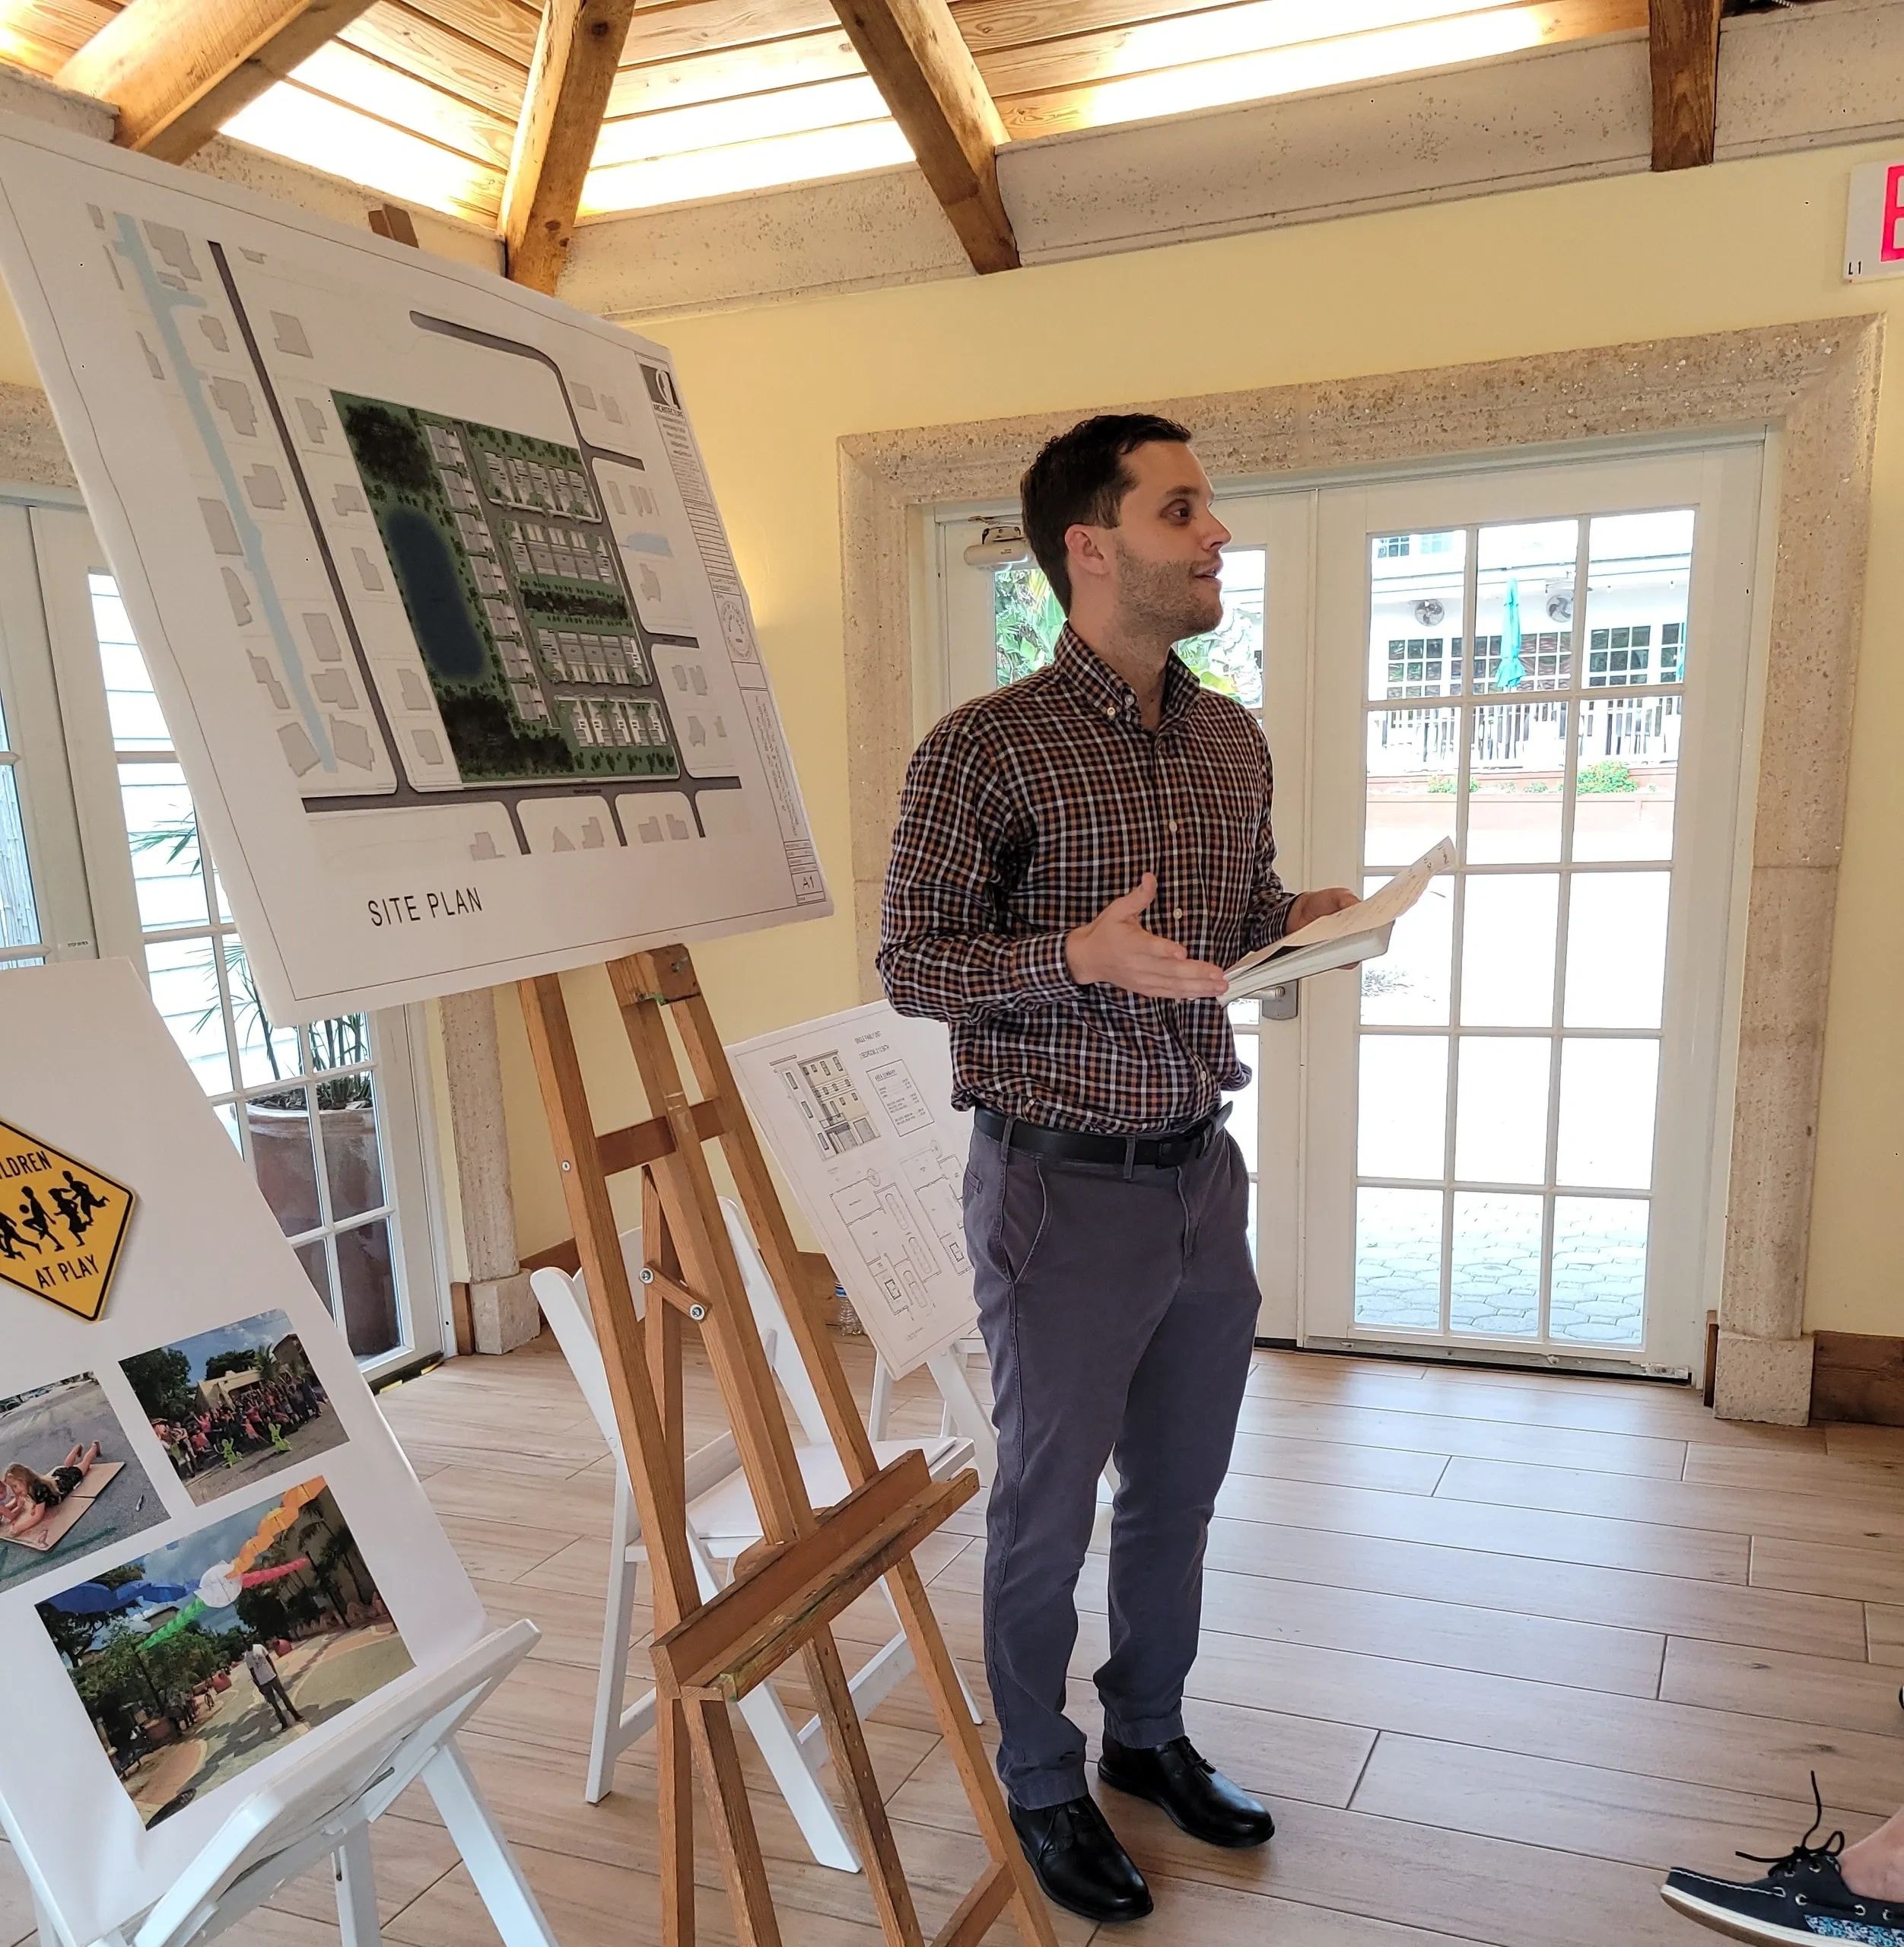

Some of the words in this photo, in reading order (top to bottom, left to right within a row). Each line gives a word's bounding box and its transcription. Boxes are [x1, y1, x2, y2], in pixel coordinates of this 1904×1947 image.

[803, 875, 815, 890] A1
[368, 895, 421, 926] SITE
[426, 887, 482, 918] PLAN
[0, 1151, 52, 1179] LDREN
[35, 1266, 56, 1289] AT
[57, 1254, 100, 1282] PLAY
